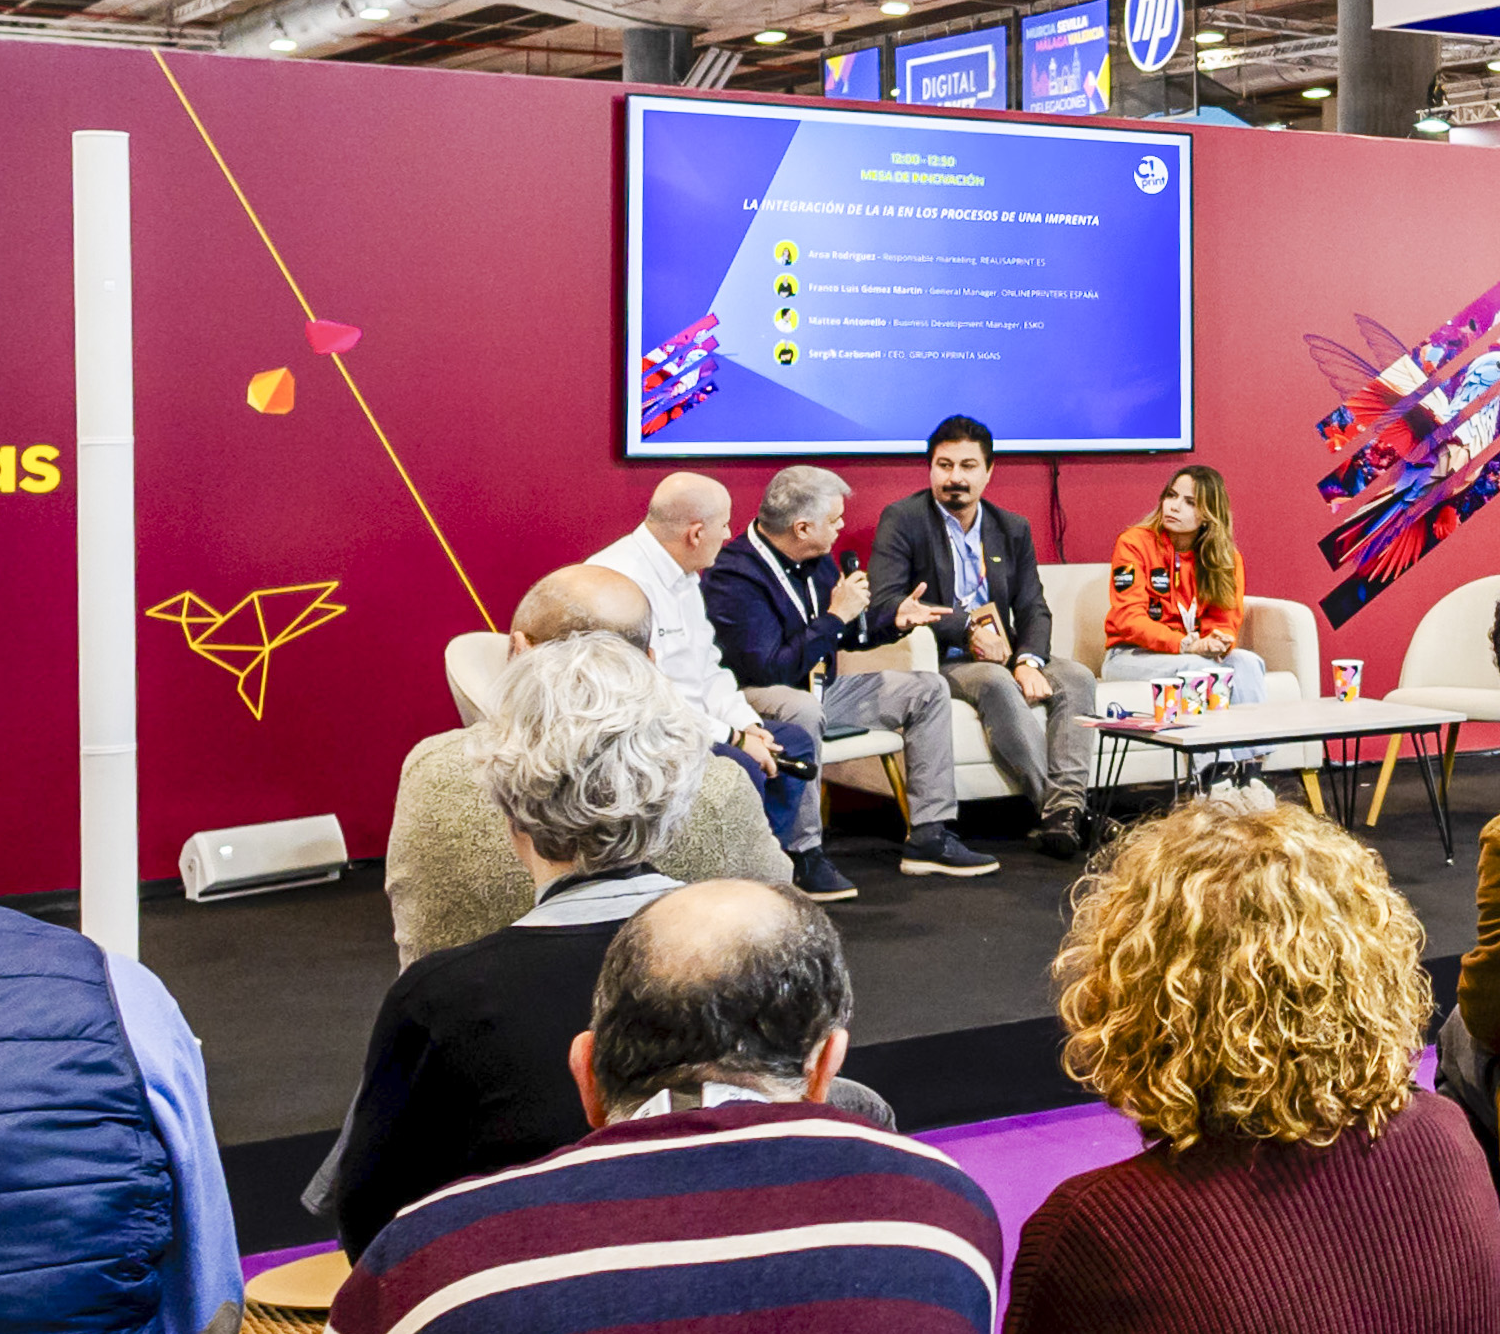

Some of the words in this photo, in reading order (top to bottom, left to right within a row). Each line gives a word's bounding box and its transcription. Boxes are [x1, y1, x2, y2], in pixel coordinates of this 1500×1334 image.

[1057, 15, 1089, 34] SEVILLA
[1068, 25, 1105, 46] VALENCIA
[922, 70, 976, 101] DIGITAL
[1030, 94, 1087, 114] DELEGACIONES
[911, 172, 985, 187] INNOVACIÓN
[1141, 177, 1165, 189] print
[743, 199, 759, 211] LA
[761, 199, 844, 215] INTEGRACIÓN
[847, 203, 863, 215] DE
[866, 204, 880, 216] LA
[883, 205, 895, 217] IA
[898, 206, 914, 218] EN
[916, 207, 939, 220] LOS
[941, 208, 999, 223] PROCESOS
[1001, 211, 1017, 223] DE
[1019, 211, 1044, 225] UNA
[1046, 213, 1100, 227] IMPRENTA
[883, 253, 935, 264] Responsable
[808, 283, 839, 293] Franco
[841, 283, 860, 293] Luis
[861, 284, 891, 295] Gómez
[929, 287, 961, 297] General
[1001, 289, 1067, 300] ONLINEPRINTERS
[1069, 289, 1099, 300] ESPAÑA
[808, 316, 839, 326] Matteo
[842, 316, 887, 327] Antonello
[893, 319, 929, 328] Business
[931, 318, 984, 329] Development
[1024, 321, 1045, 330] ESKO
[838, 349, 882, 359] Carbonell
[909, 351, 939, 360] GRUPO
[977, 352, 1001, 361] SIGNS
